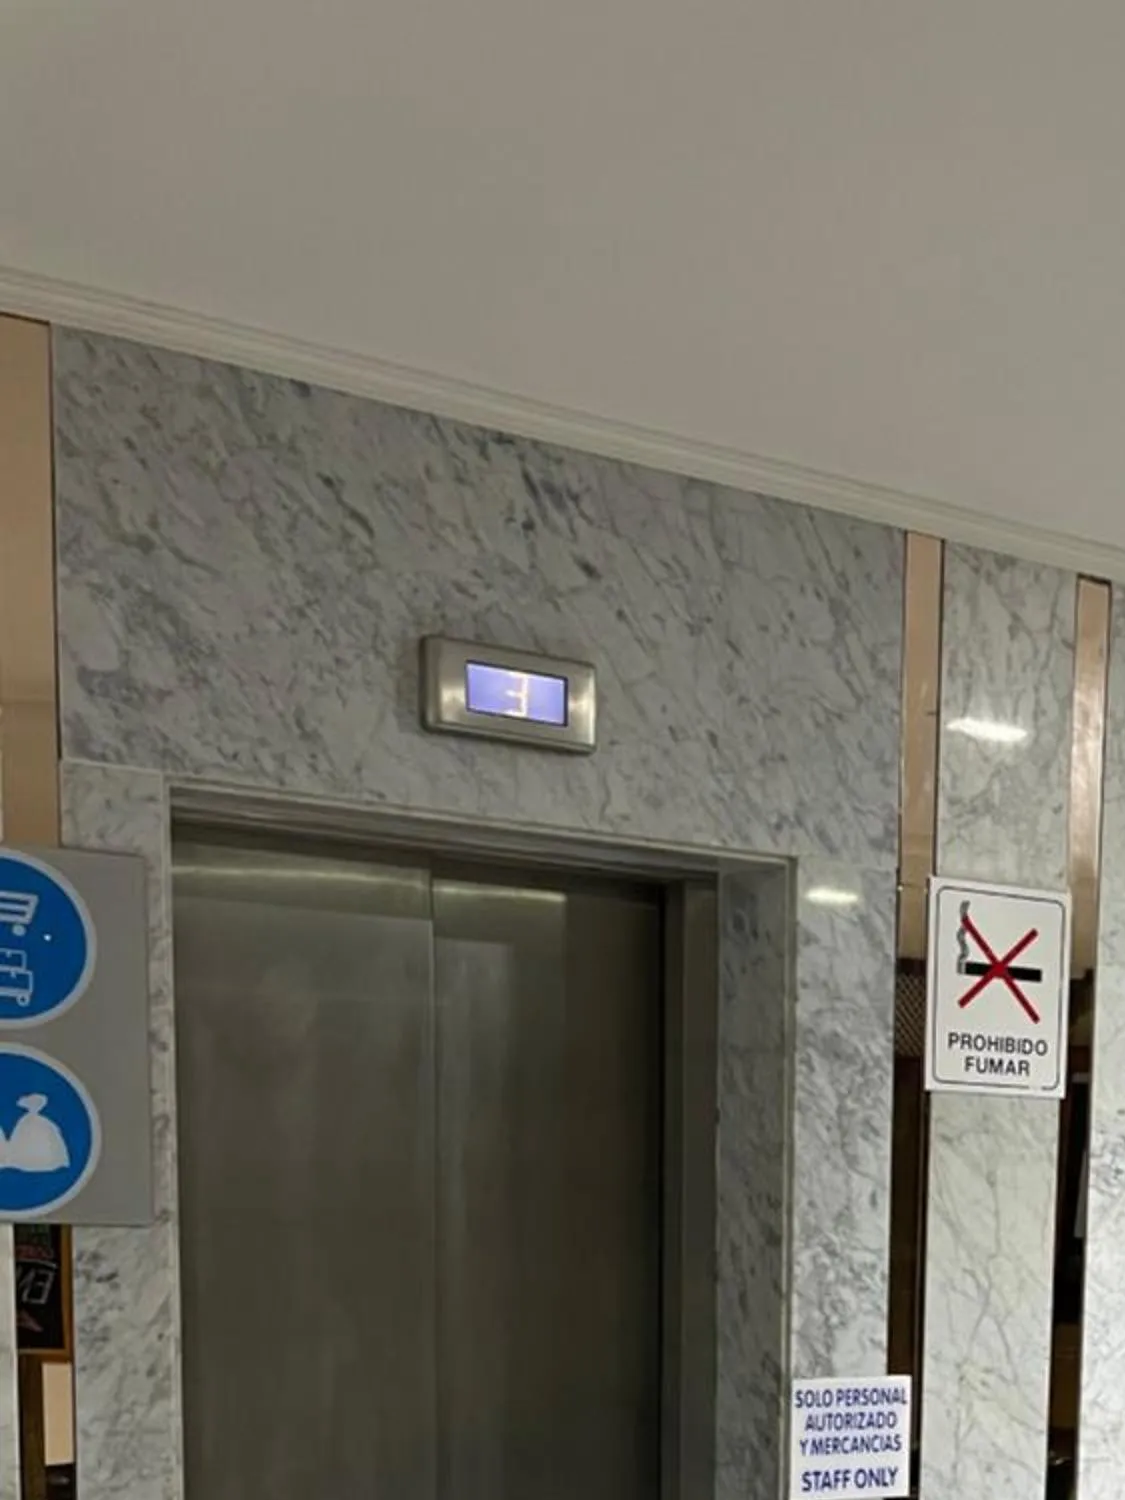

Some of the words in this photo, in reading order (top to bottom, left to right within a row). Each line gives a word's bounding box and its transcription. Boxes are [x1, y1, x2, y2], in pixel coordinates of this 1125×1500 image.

[504, 671, 529, 718] 3
[947, 1031, 1048, 1056] PROHIBIDO
[964, 1056, 1030, 1077] FUMAR
[795, 1389, 833, 1408] SOLO
[836, 1387, 907, 1406] PERSONAL
[804, 1411, 897, 1431] AUTORIZADO
[799, 1438, 809, 1456] Y
[809, 1434, 902, 1456] MERCANCIAS
[801, 1469, 850, 1492] STAFF
[853, 1466, 898, 1489] ONLY
